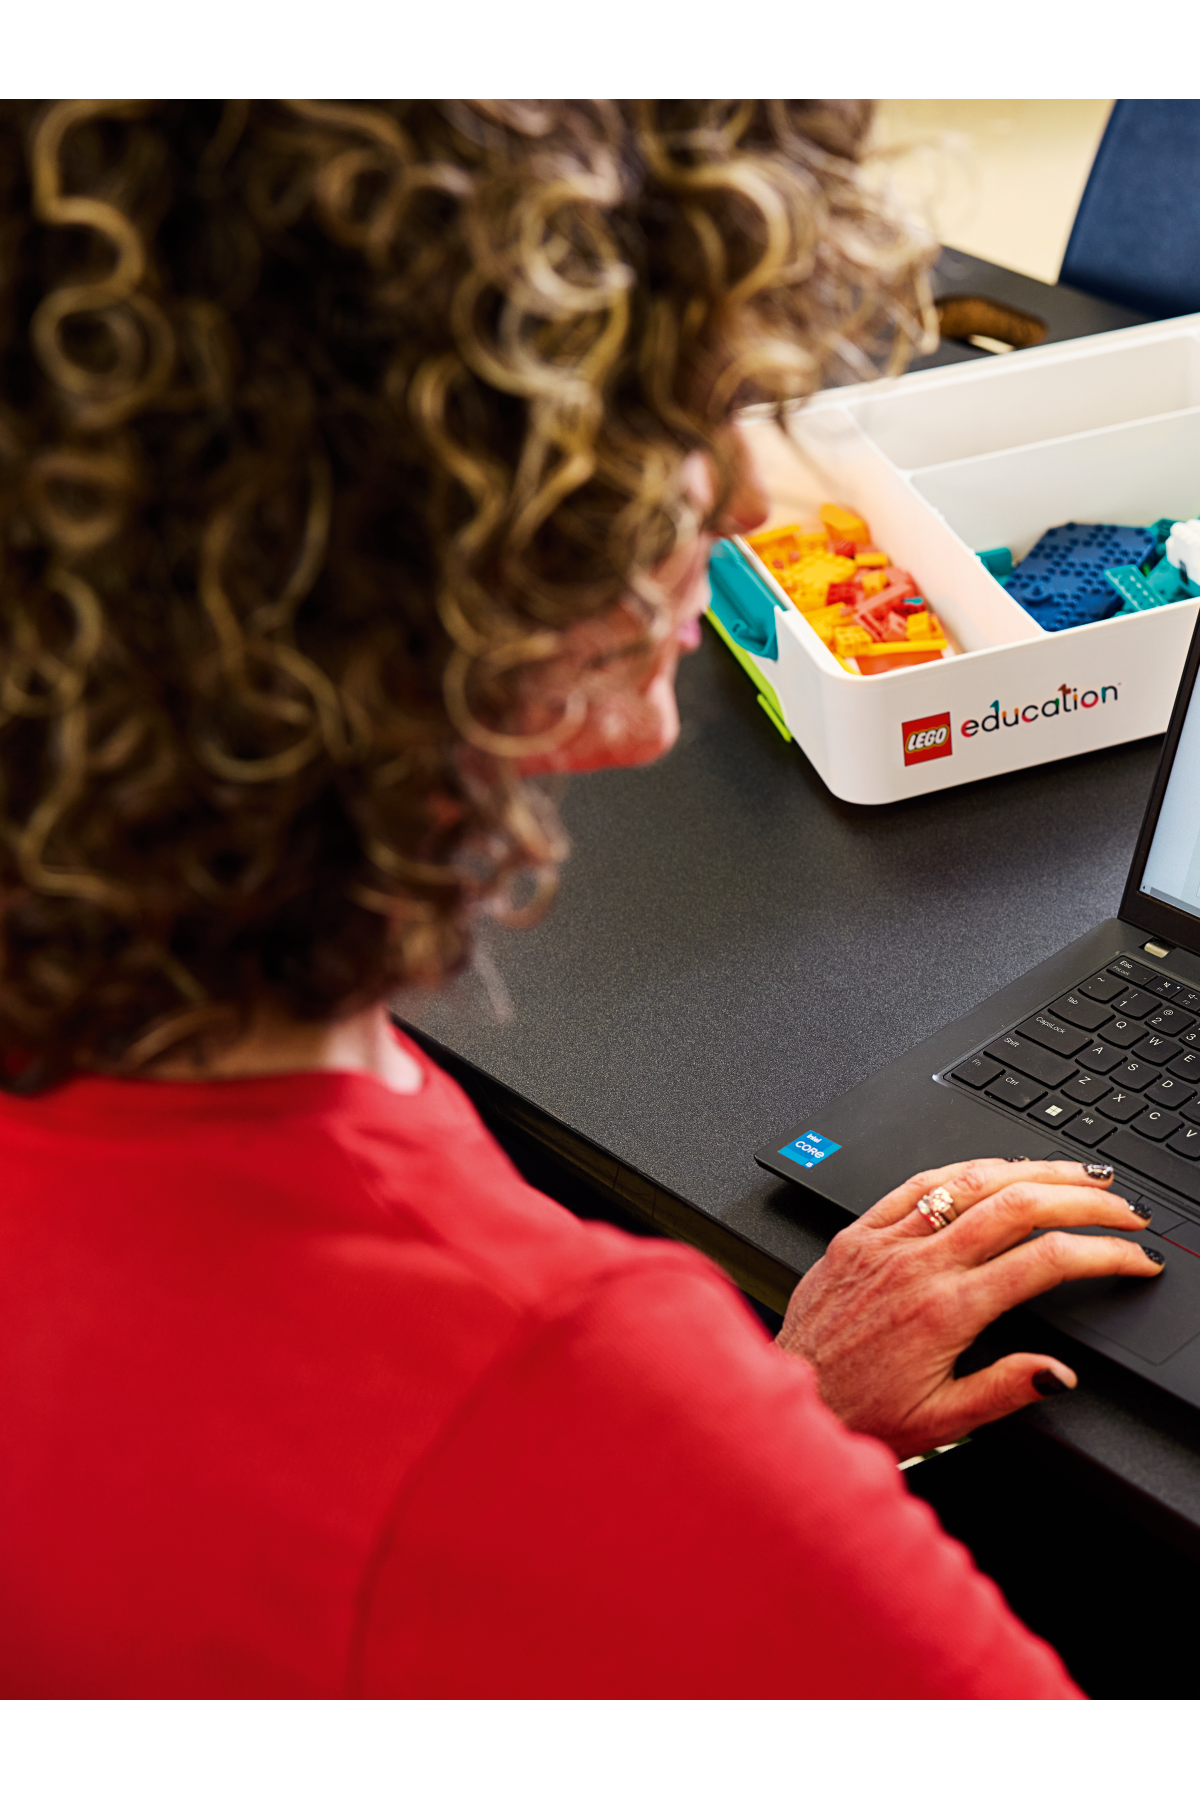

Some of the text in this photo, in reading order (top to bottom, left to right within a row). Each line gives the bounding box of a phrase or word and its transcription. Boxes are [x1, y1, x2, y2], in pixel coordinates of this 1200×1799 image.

[907, 684, 1119, 753] LEGO education
[1119, 999, 1128, 1008] 1
[1035, 1016, 1066, 1035] CapsLock
[1115, 1020, 1128, 1030] Q
[1150, 1016, 1163, 1025] 2
[1003, 1037, 1020, 1048] Shift
[1148, 1036, 1164, 1047] W
[1185, 1033, 1197, 1042] 3
[1091, 1046, 1104, 1055] A
[1183, 1053, 1197, 1064] E
[1127, 1063, 1140, 1072] S
[1004, 1076, 1020, 1086] Ctrl
[1078, 1075, 1092, 1086] Z
[1161, 1079, 1174, 1089] D
[1112, 1093, 1127, 1103] X
[1081, 1116, 1095, 1126] Alt
[1148, 1111, 1162, 1121] C
[1185, 1128, 1198, 1138] V
